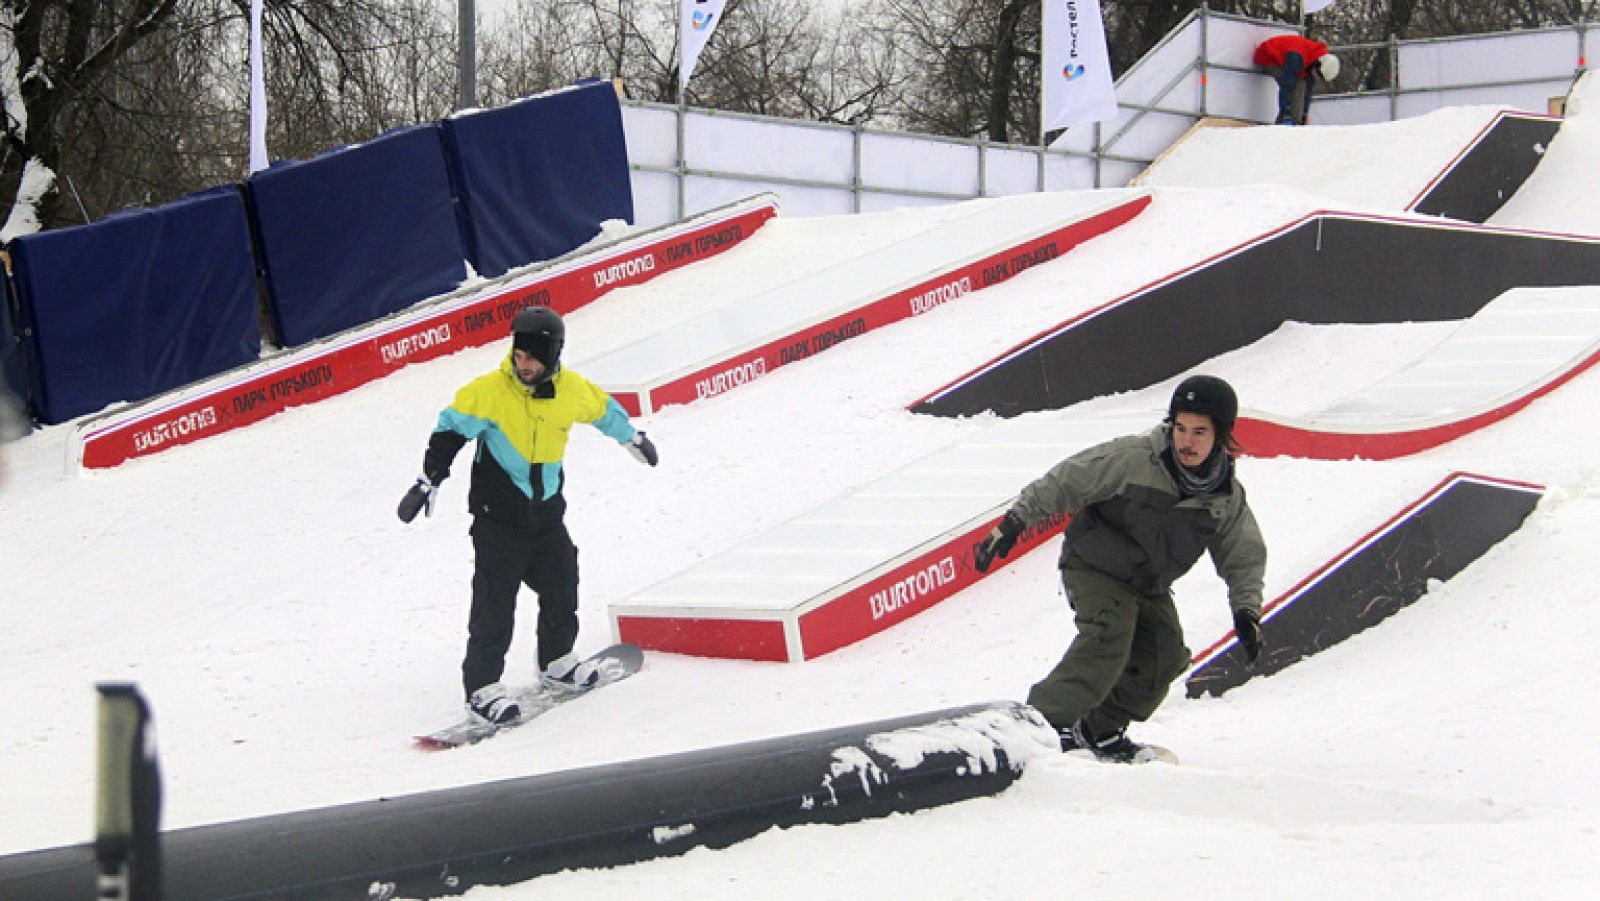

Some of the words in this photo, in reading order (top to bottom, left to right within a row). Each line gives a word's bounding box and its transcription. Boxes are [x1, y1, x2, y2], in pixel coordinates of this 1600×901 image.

[594, 257, 643, 288] BURTON
[666, 240, 693, 262] ПАРК
[696, 225, 742, 251] ГОРЬКОГО
[983, 263, 1008, 286] ПАРК
[1010, 241, 1057, 274] ГОРЬКОГО
[380, 328, 441, 364] BURTON
[464, 310, 496, 333] ПАРК
[780, 340, 810, 364] ПАРК
[813, 318, 866, 353] ГОРЬКОГО
[133, 412, 202, 451] BURTON
[232, 387, 267, 416] ПАРК
[270, 363, 333, 401] ГОРЬКОГО
[869, 564, 940, 621] BURTON
